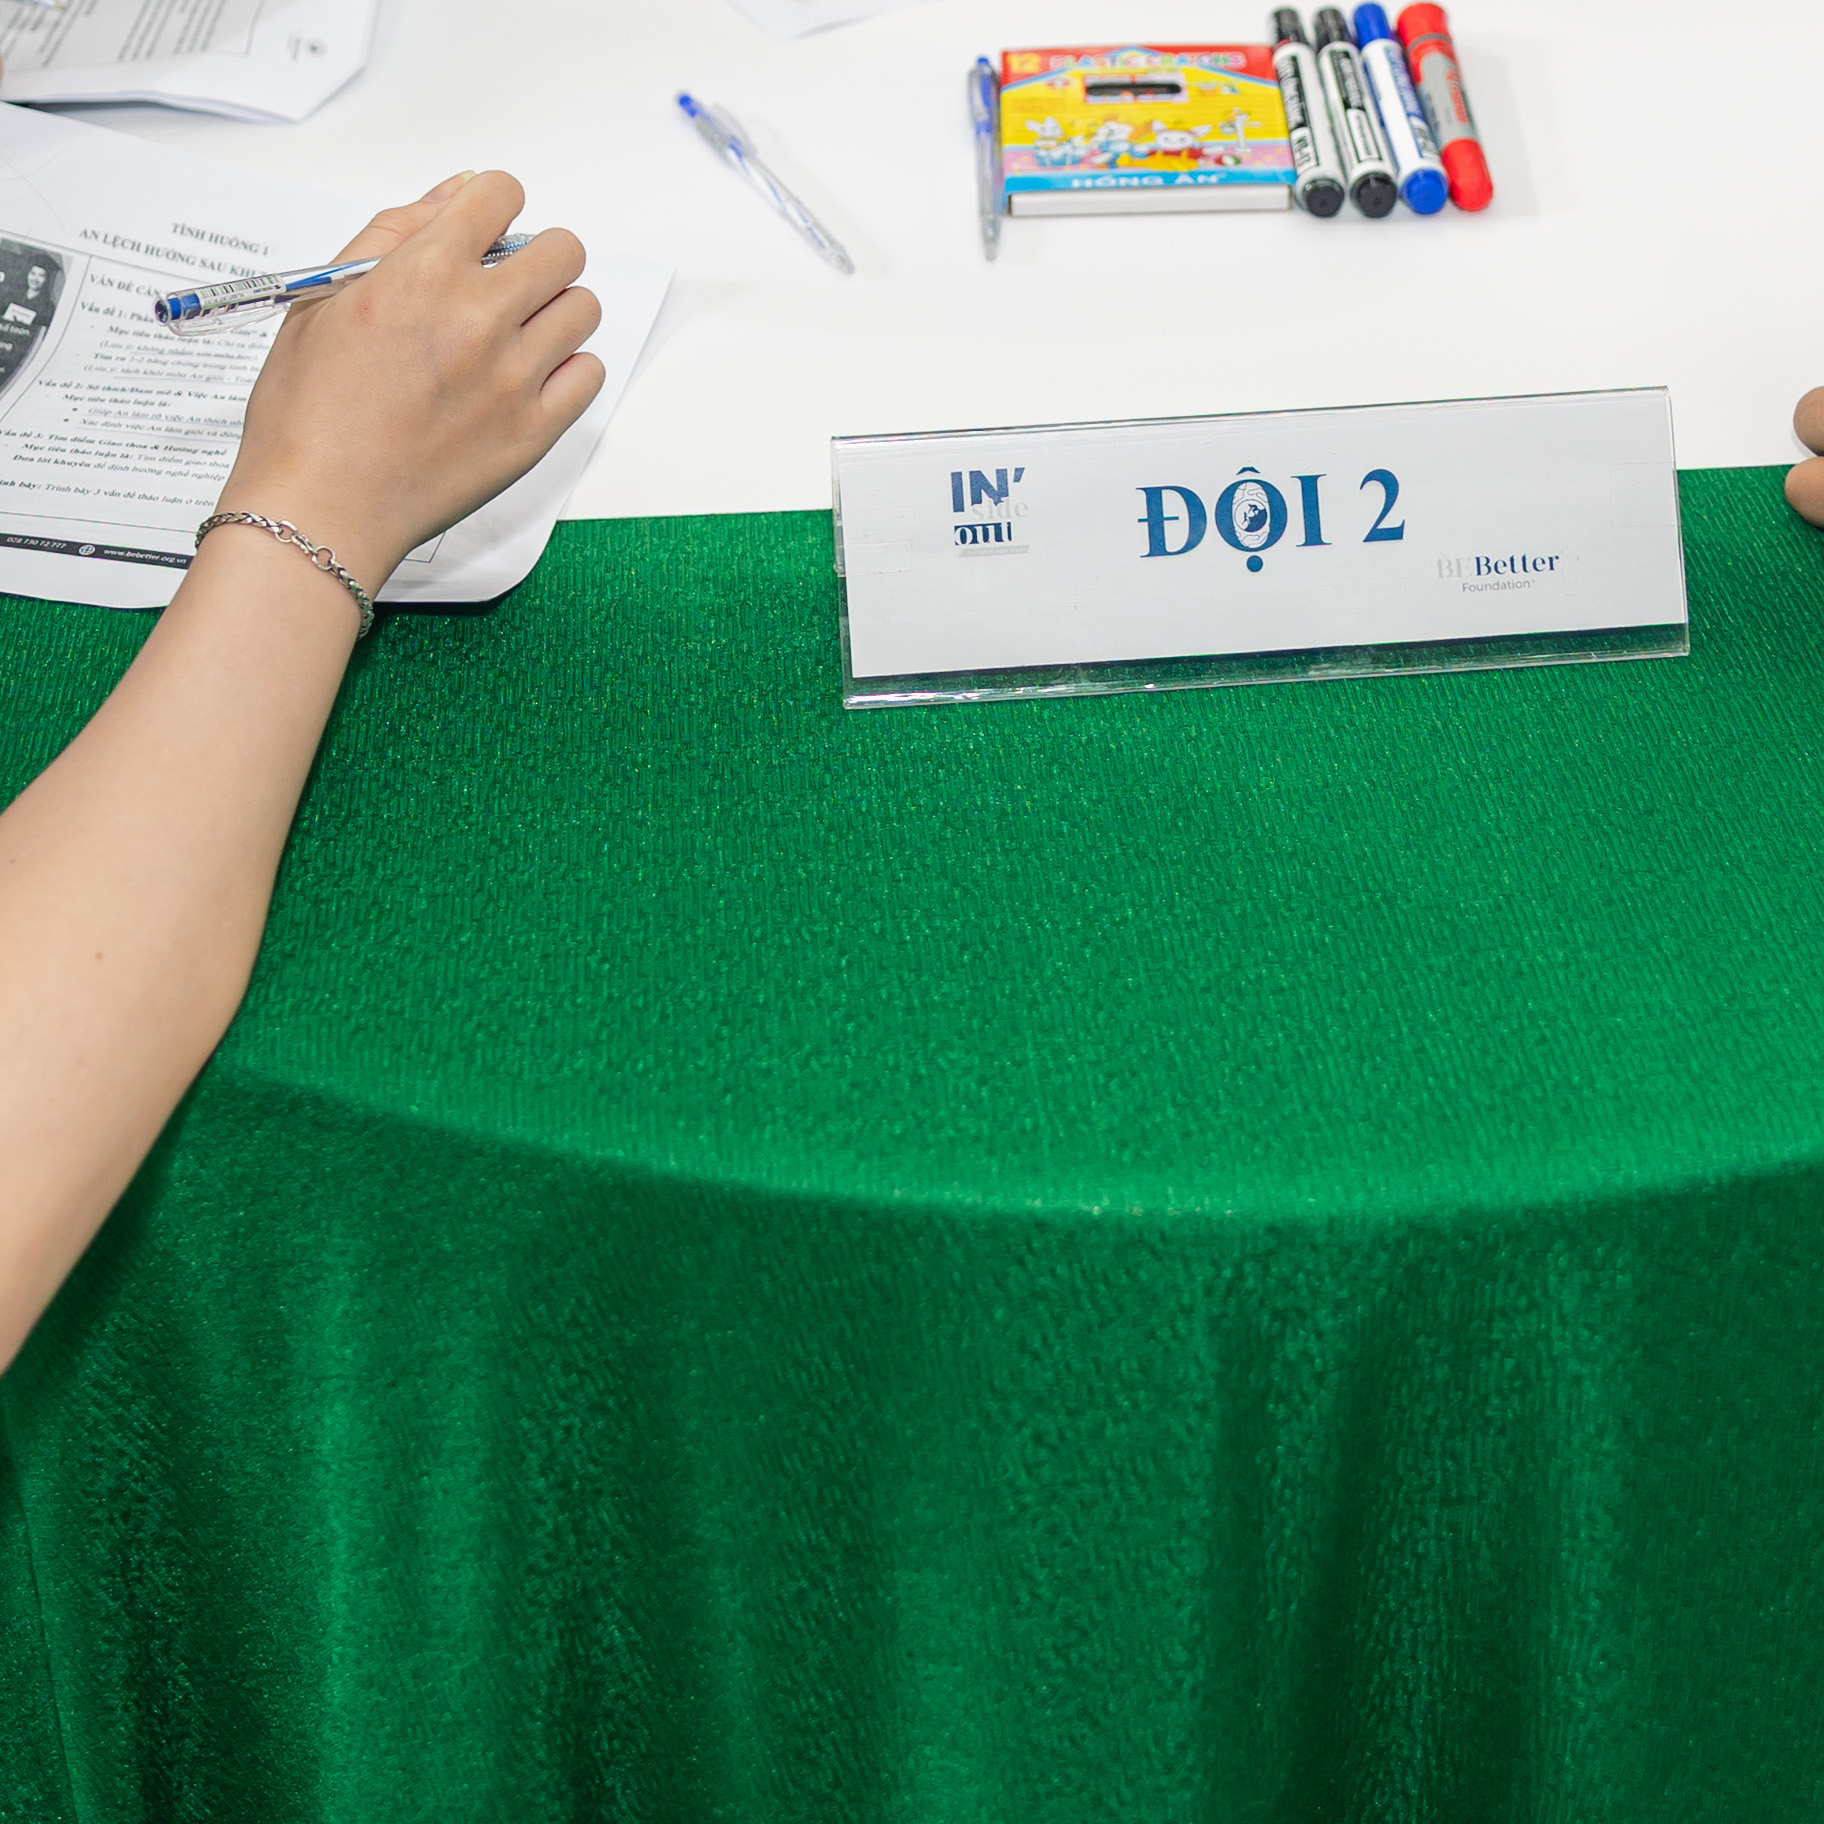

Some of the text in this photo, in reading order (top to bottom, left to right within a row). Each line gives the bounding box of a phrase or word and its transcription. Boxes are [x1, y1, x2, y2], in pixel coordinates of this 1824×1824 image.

[1006, 52, 1040, 73] 12
[1136, 466, 1405, 573] ĐỘI 2
